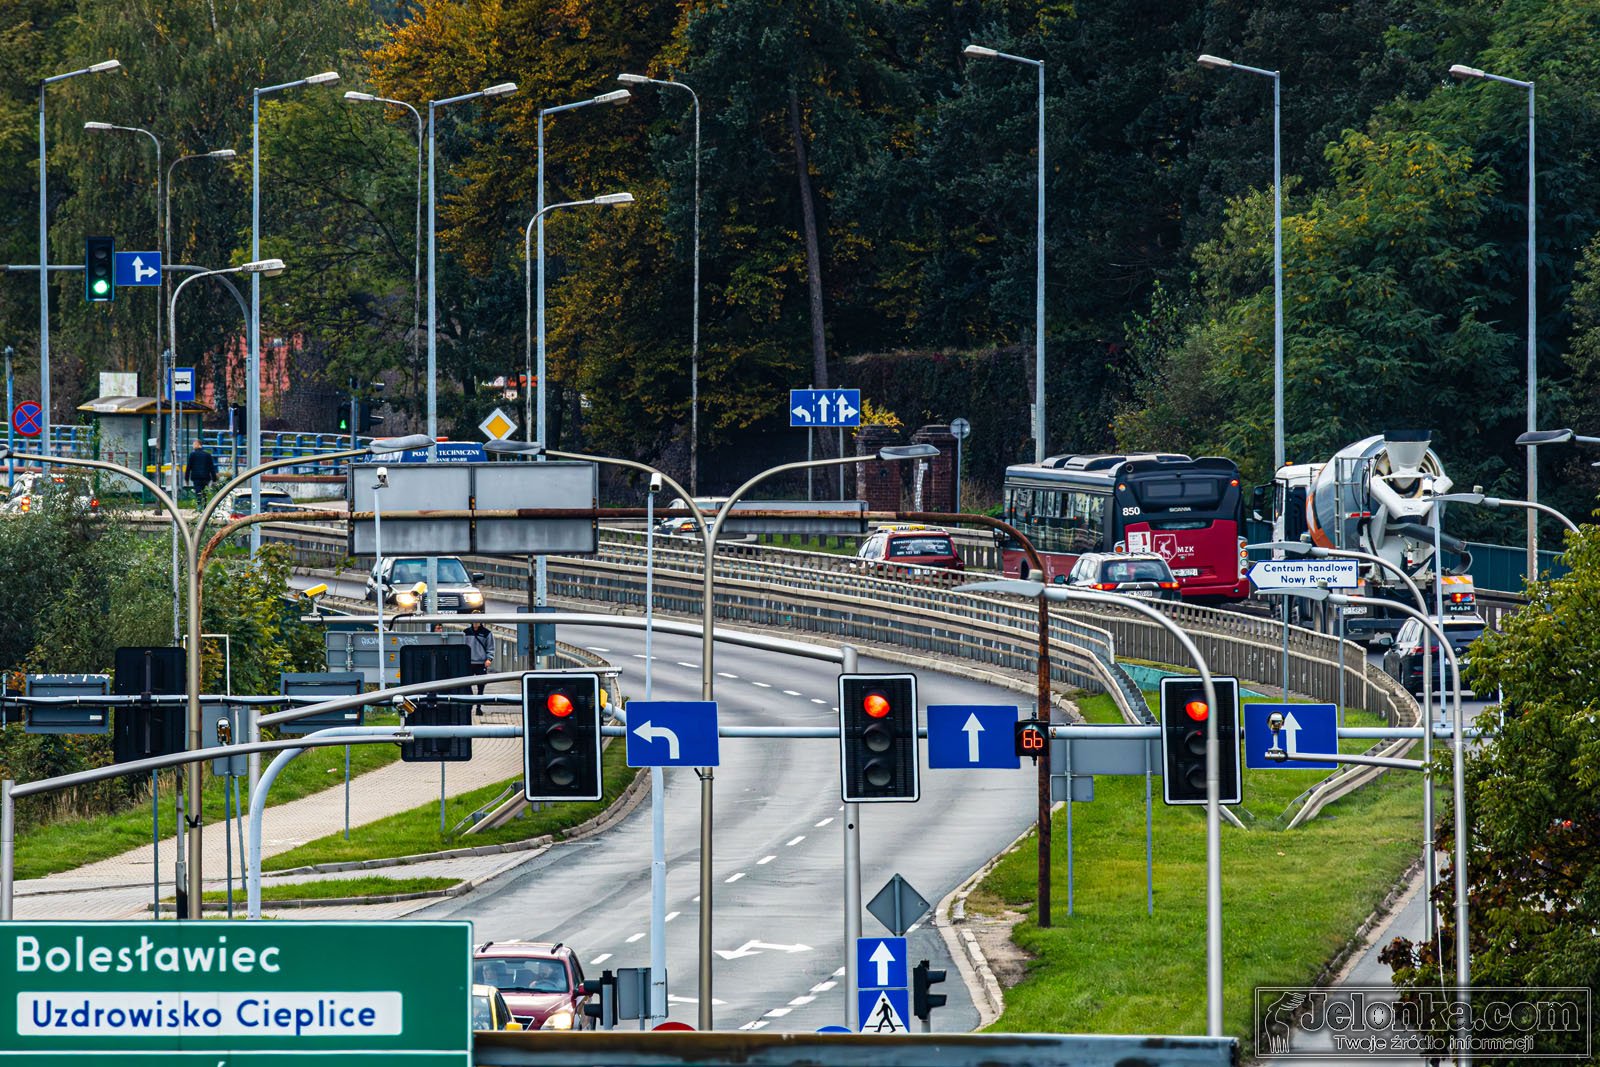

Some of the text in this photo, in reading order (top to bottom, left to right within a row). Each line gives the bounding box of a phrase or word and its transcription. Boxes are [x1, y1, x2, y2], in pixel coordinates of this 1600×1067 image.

[1122, 506, 1141, 516] 850
[1263, 563, 1354, 573] Centrum handlowe
[1280, 575, 1306, 585] Nowy
[1023, 729, 1043, 749] 66
[16, 935, 281, 973] Bolesławiec
[32, 999, 377, 1036] Uzdrowisko Cieplice
